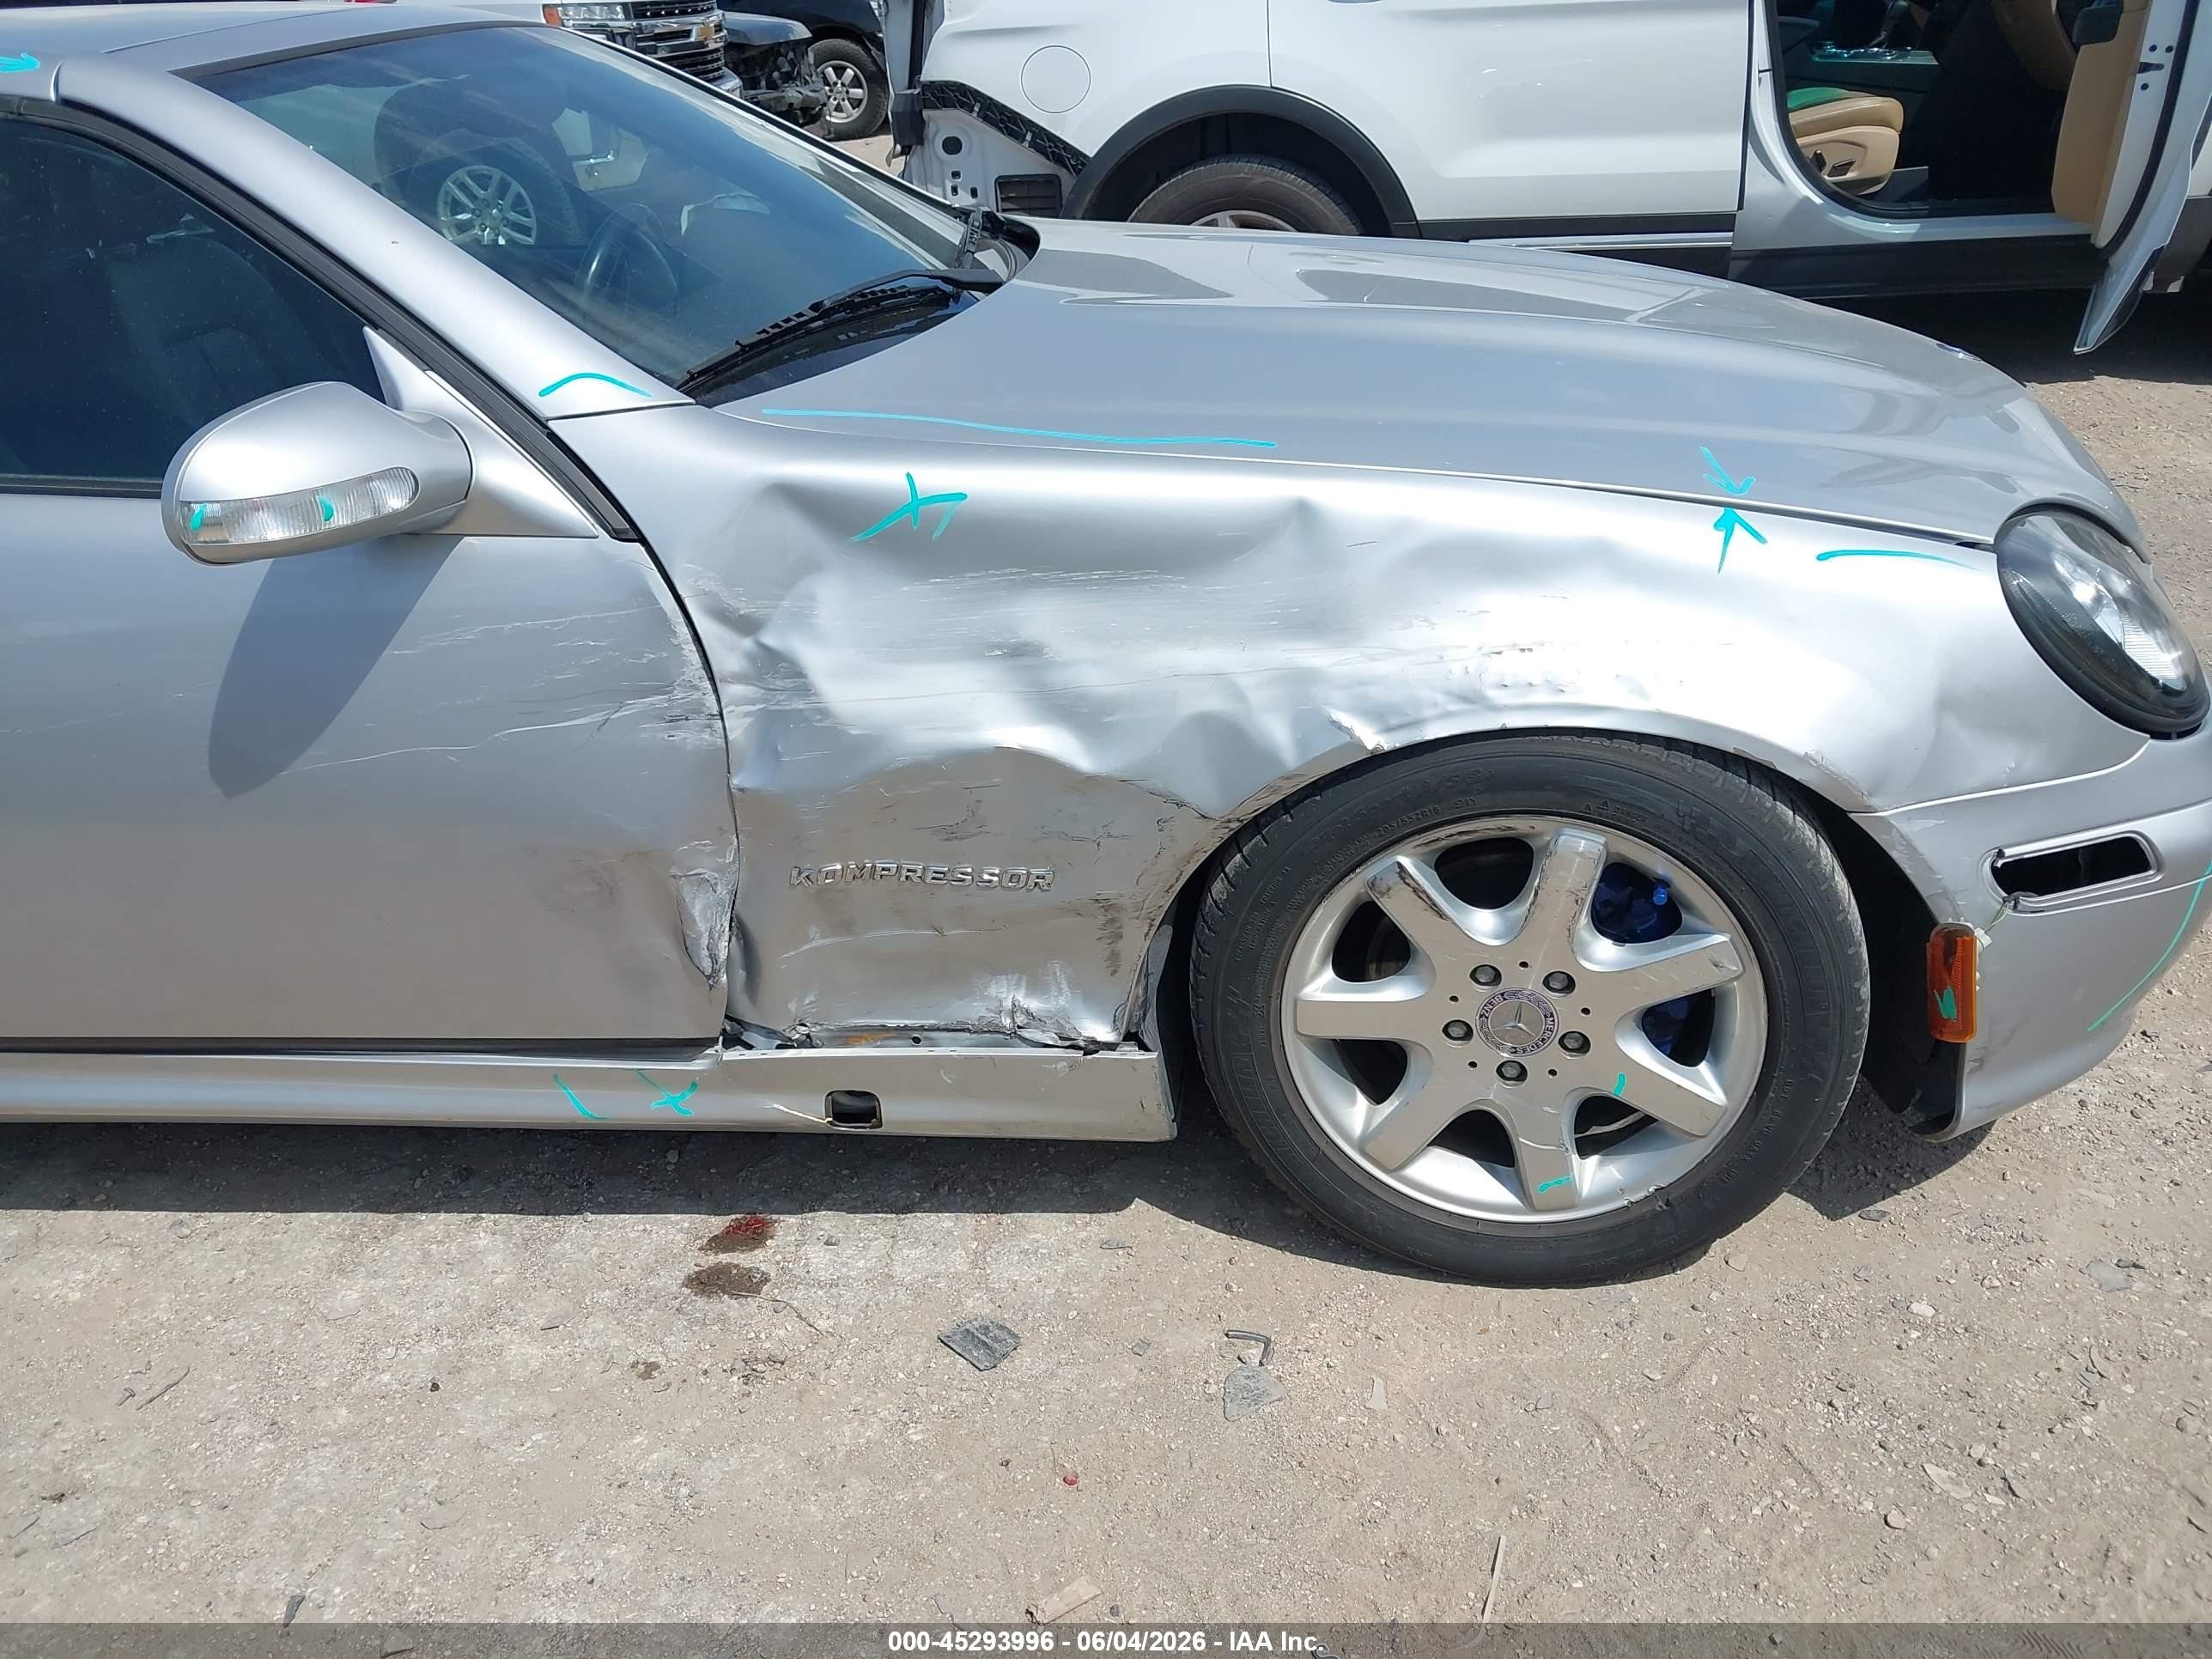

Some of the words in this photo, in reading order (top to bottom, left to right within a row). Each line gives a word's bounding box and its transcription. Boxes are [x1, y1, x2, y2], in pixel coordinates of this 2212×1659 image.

[789, 860, 1055, 890] KOMPRESSOR
[1480, 994, 1504, 1019] BENZ
[1515, 1017, 1555, 1055] MERCEDES
